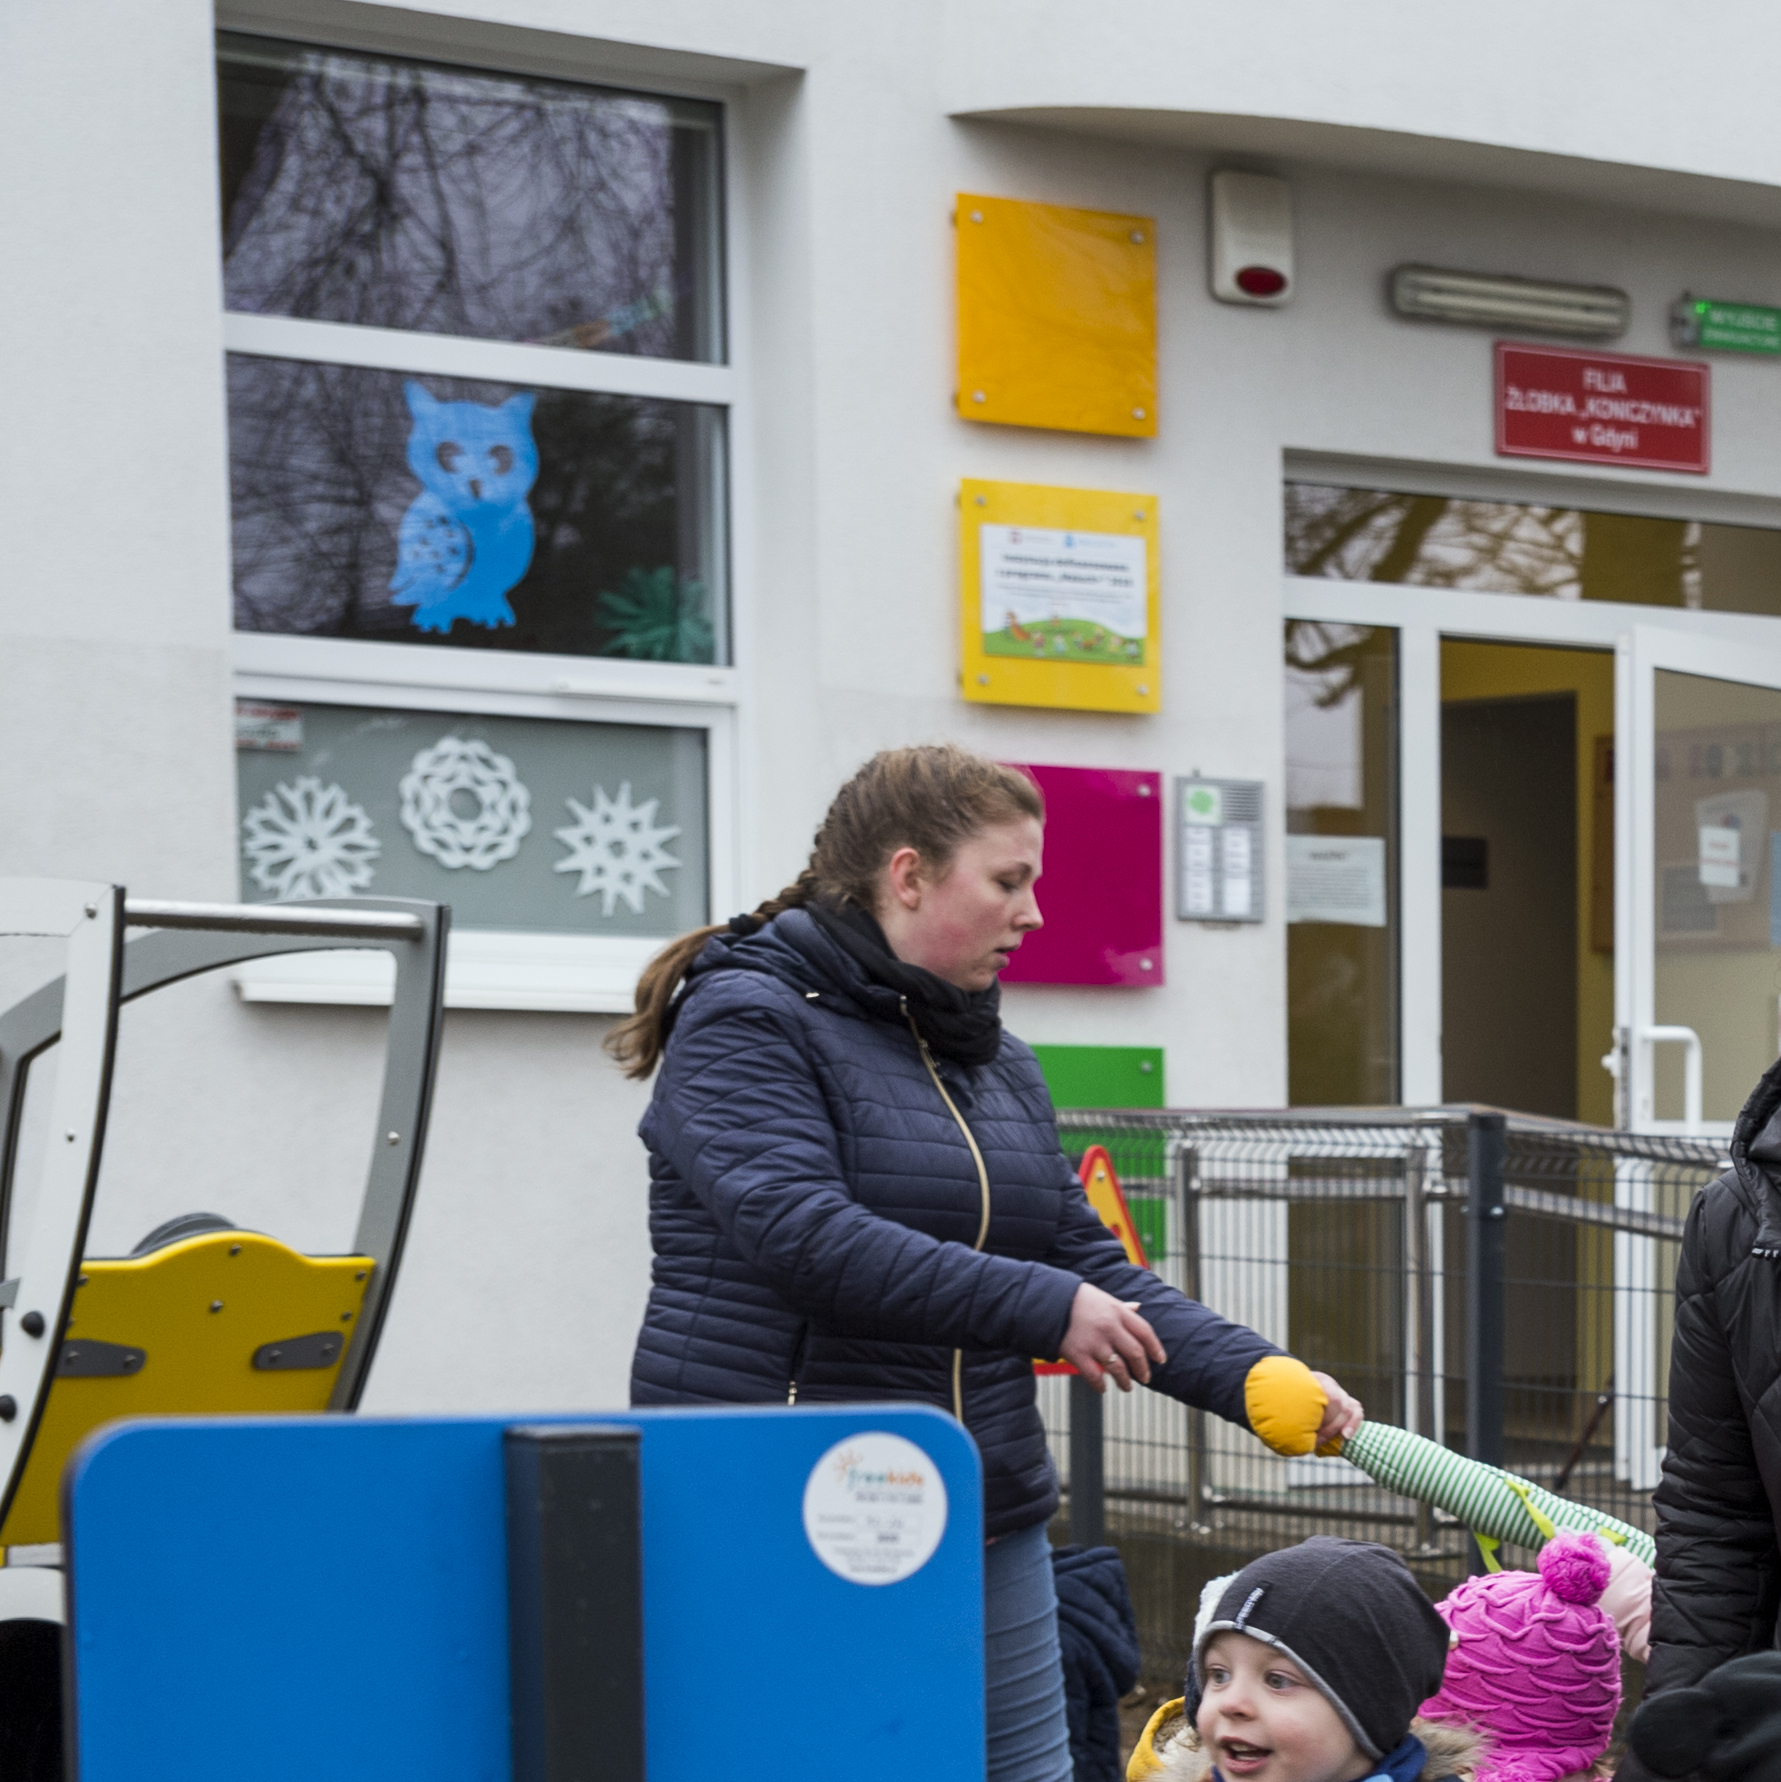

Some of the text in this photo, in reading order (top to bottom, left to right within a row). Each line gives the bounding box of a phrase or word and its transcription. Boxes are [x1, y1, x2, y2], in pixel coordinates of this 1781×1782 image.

[1582, 366, 1628, 394] FILIA
[1571, 423, 1639, 453] w Gdyni
